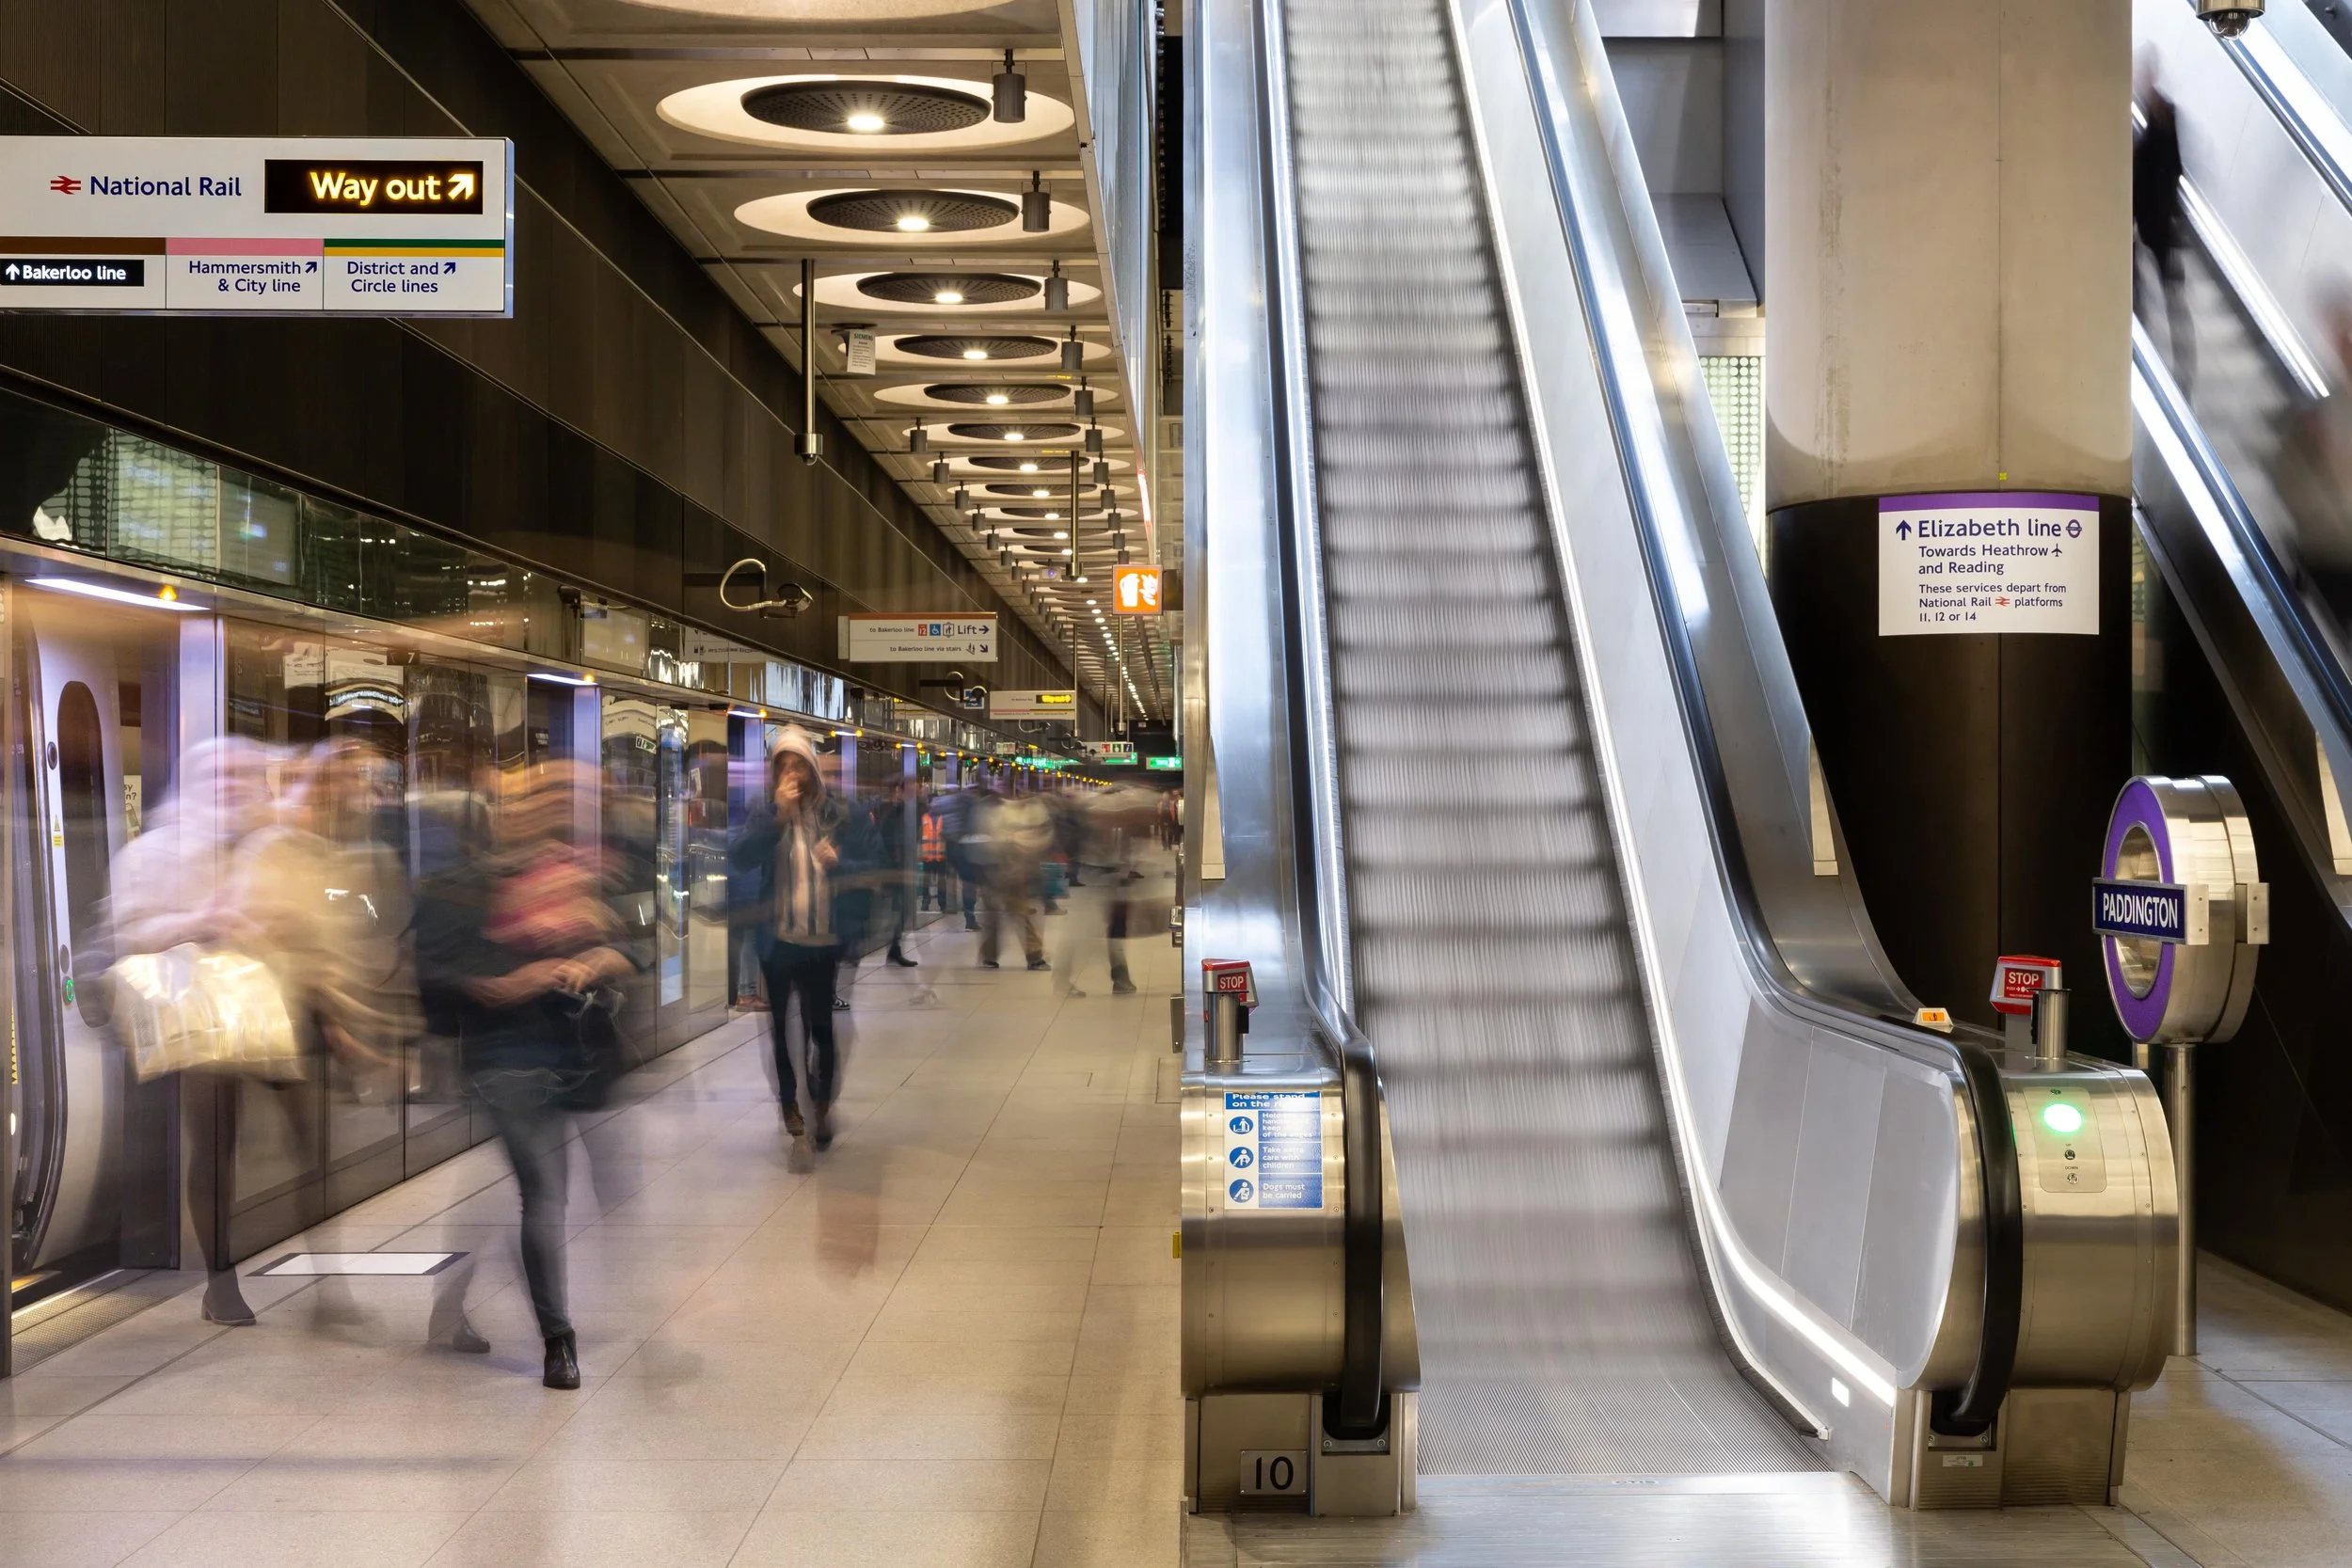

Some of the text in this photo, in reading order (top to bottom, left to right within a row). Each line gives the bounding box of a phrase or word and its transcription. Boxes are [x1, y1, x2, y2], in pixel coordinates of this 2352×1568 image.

[90, 176, 242, 197] National Rail
[310, 171, 440, 206] Way out
[23, 264, 126, 280] Bakerloo line
[189, 261, 301, 275] Hammersmith
[347, 261, 438, 275] District and
[217, 278, 300, 294] & City line
[351, 279, 437, 293] Circle lines
[1918, 518, 2061, 537] Elizabeth line
[1919, 544, 2048, 557] Towards Heathrow
[1918, 562, 2004, 575] and Reading
[1919, 583, 2066, 594] These services depart from
[1919, 596, 2062, 609] National Rail platforms
[1935, 611, 1945, 621] 12
[1948, 612, 1960, 621] or
[1965, 611, 1976, 621] 14
[958, 625, 977, 635] Lift
[2103, 893, 2178, 928] PADDINGTON
[1219, 975, 1244, 990] STOP
[2009, 972, 2039, 985] STOP
[1263, 1183, 1282, 1192] Dogs
[1255, 1456, 1294, 1490] 10
